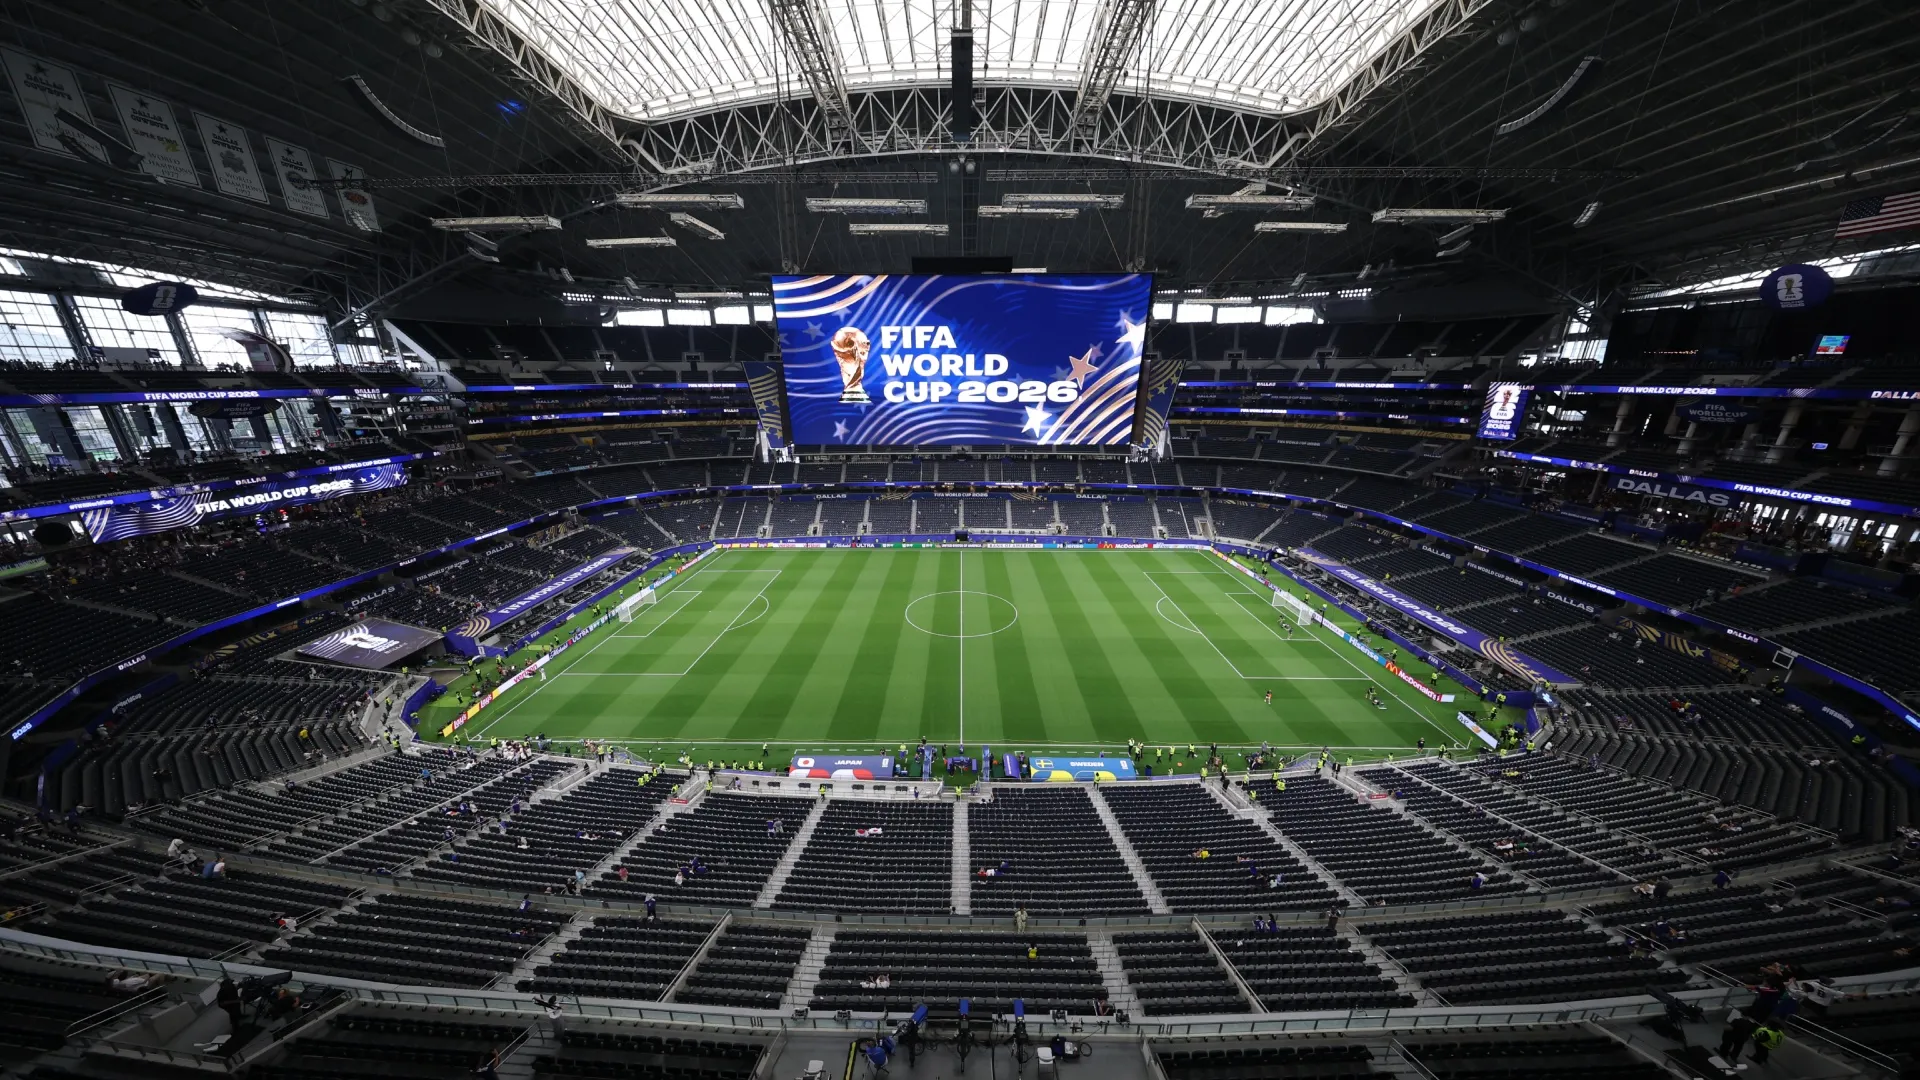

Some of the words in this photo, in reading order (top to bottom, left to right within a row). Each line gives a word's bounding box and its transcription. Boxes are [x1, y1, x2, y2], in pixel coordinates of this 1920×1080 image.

[881, 325, 957, 349] FIFA
[881, 353, 1009, 377] WORLD
[144, 392, 170, 401] FIFA
[169, 391, 207, 400] WORLD
[207, 391, 227, 399] CUP
[227, 390, 260, 398] 2026
[883, 381, 952, 403] CUP
[957, 380, 1079, 403] 2026
[1871, 391, 1920, 400] DALLA
[1705, 404, 1727, 412] FIFA
[342, 461, 363, 470] WORLD
[1628, 469, 1659, 478] DALLAS
[234, 475, 268, 487] DALLAS
[195, 498, 232, 515] FIFA
[231, 490, 284, 508] WORLD
[283, 485, 309, 499] CUP
[308, 478, 352, 495] 2026
[1616, 478, 1730, 507] DALLAS
[1733, 483, 1755, 493] FIFA
[1754, 486, 1791, 498] WORLD
[1790, 491, 1813, 501] CUP
[1811, 495, 1853, 507] 2026
[485, 542, 515, 558] DALLAS
[1421, 545, 1452, 560] DALLAS
[427, 567, 446, 578] WORLD
[1466, 561, 1478, 570] FIFA
[1477, 565, 1496, 576] WORLD
[1494, 570, 1506, 579] CUP
[1504, 574, 1525, 587] 2026
[1558, 573, 1570, 581] FIFA
[1568, 575, 1588, 587] WORLD
[1586, 580, 1598, 590] CUP
[498, 599, 532, 614] FIFA
[523, 580, 567, 602] WORLD
[562, 571, 583, 583] CUP
[580, 557, 611, 573] 2026
[350, 586, 396, 607] DALLAS
[1335, 569, 1361, 580] FIFA
[1356, 578, 1397, 600] WORLD
[1392, 597, 1421, 611] CUP
[1413, 608, 1468, 635] 2026
[1547, 591, 1595, 613] DALLAS
[530, 630, 541, 640] FIFA
[571, 627, 590, 643] ULTRA
[1726, 628, 1760, 644] DALLAS
[1348, 637, 1380, 662] Hisense
[117, 654, 148, 672] DALLAS
[1427, 655, 1440, 666] FIFA
[1398, 669, 1438, 702] McDonald's
[453, 711, 468, 731] Lay's
[11, 721, 34, 740] 2026
